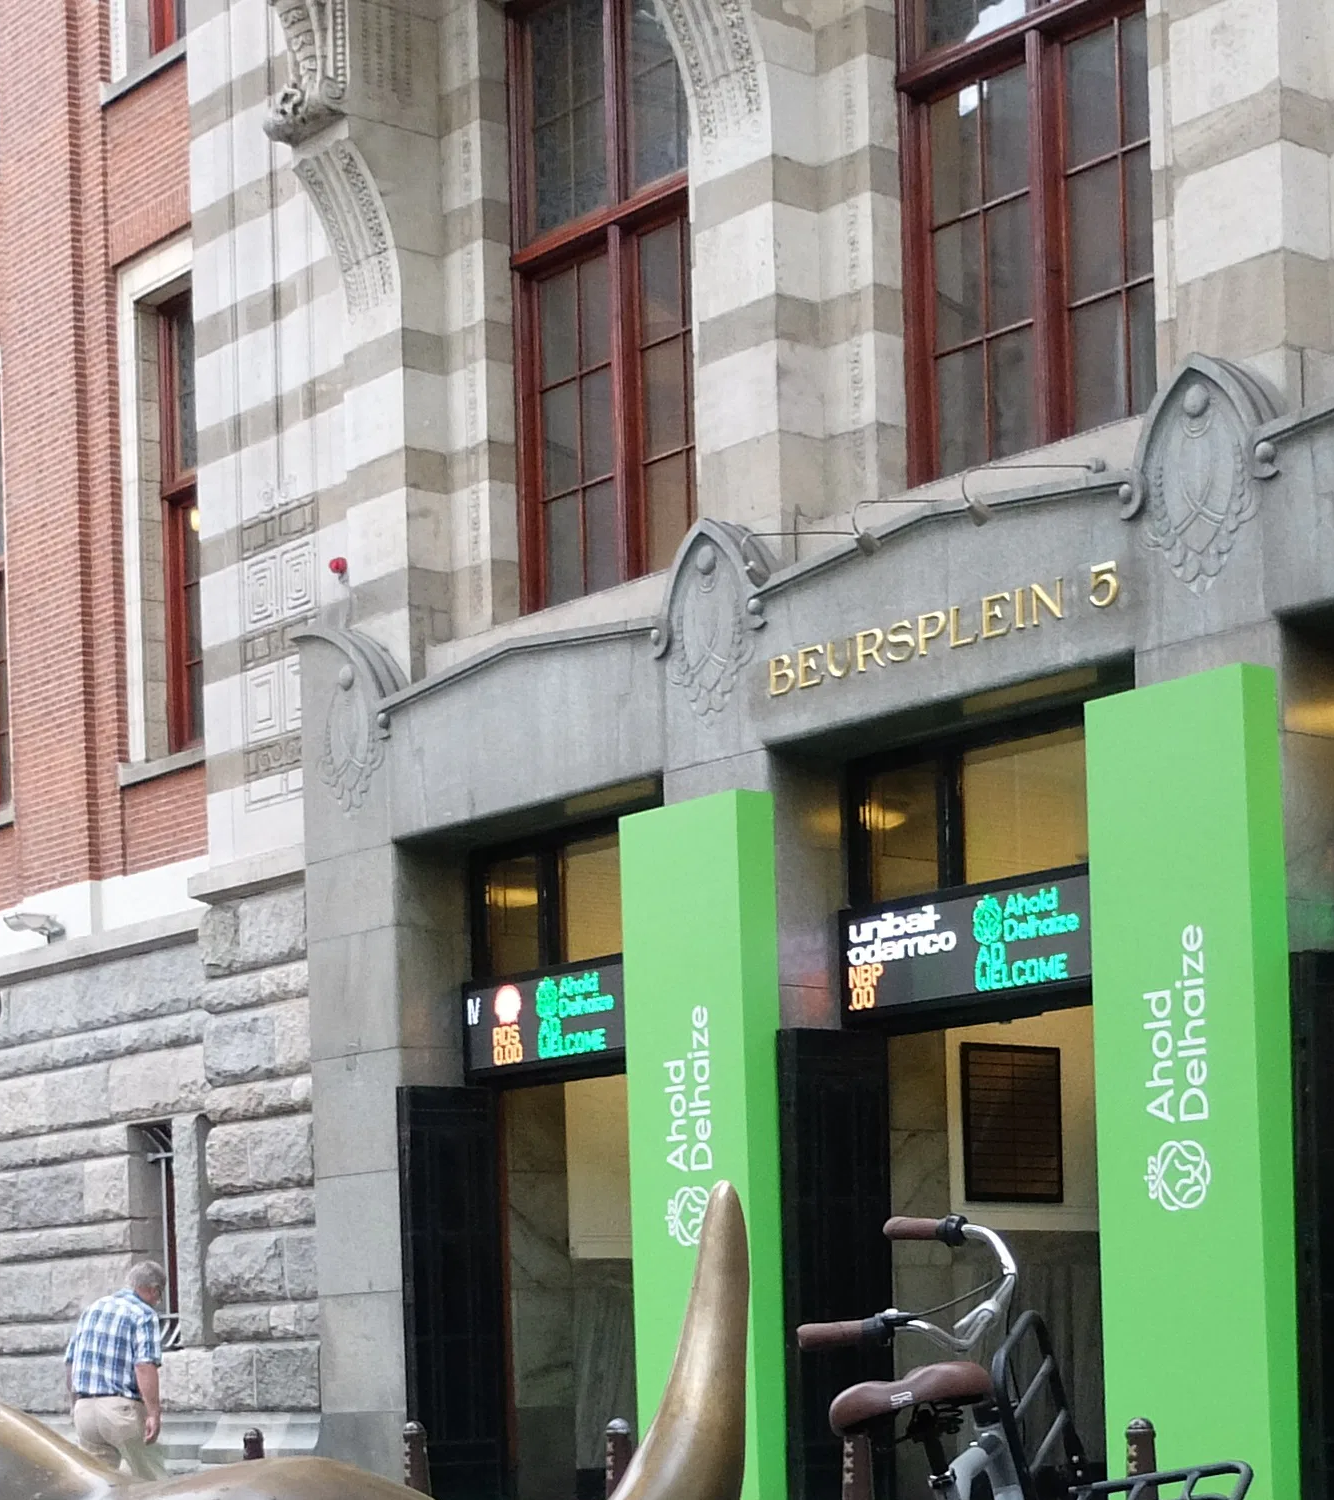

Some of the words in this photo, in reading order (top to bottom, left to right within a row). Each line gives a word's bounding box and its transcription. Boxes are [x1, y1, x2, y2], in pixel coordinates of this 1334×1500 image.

[769, 576, 1065, 698] BEURSPLEIN
[1089, 560, 1119, 608] 5
[1004, 886, 1059, 917] Ahold
[1003, 911, 1080, 942] Delhaize
[847, 930, 957, 966] odamco
[977, 942, 1006, 967] AD
[559, 971, 599, 998] Ahold
[974, 953, 1069, 992] WELCOME
[558, 991, 615, 1019] Delhaize
[1174, 924, 1209, 1122] Delhaize
[538, 1027, 607, 1059] WELCOME
[1142, 989, 1176, 1124] Ahold
[687, 1005, 713, 1171] Delhaize
[663, 1059, 689, 1172] Ahold
